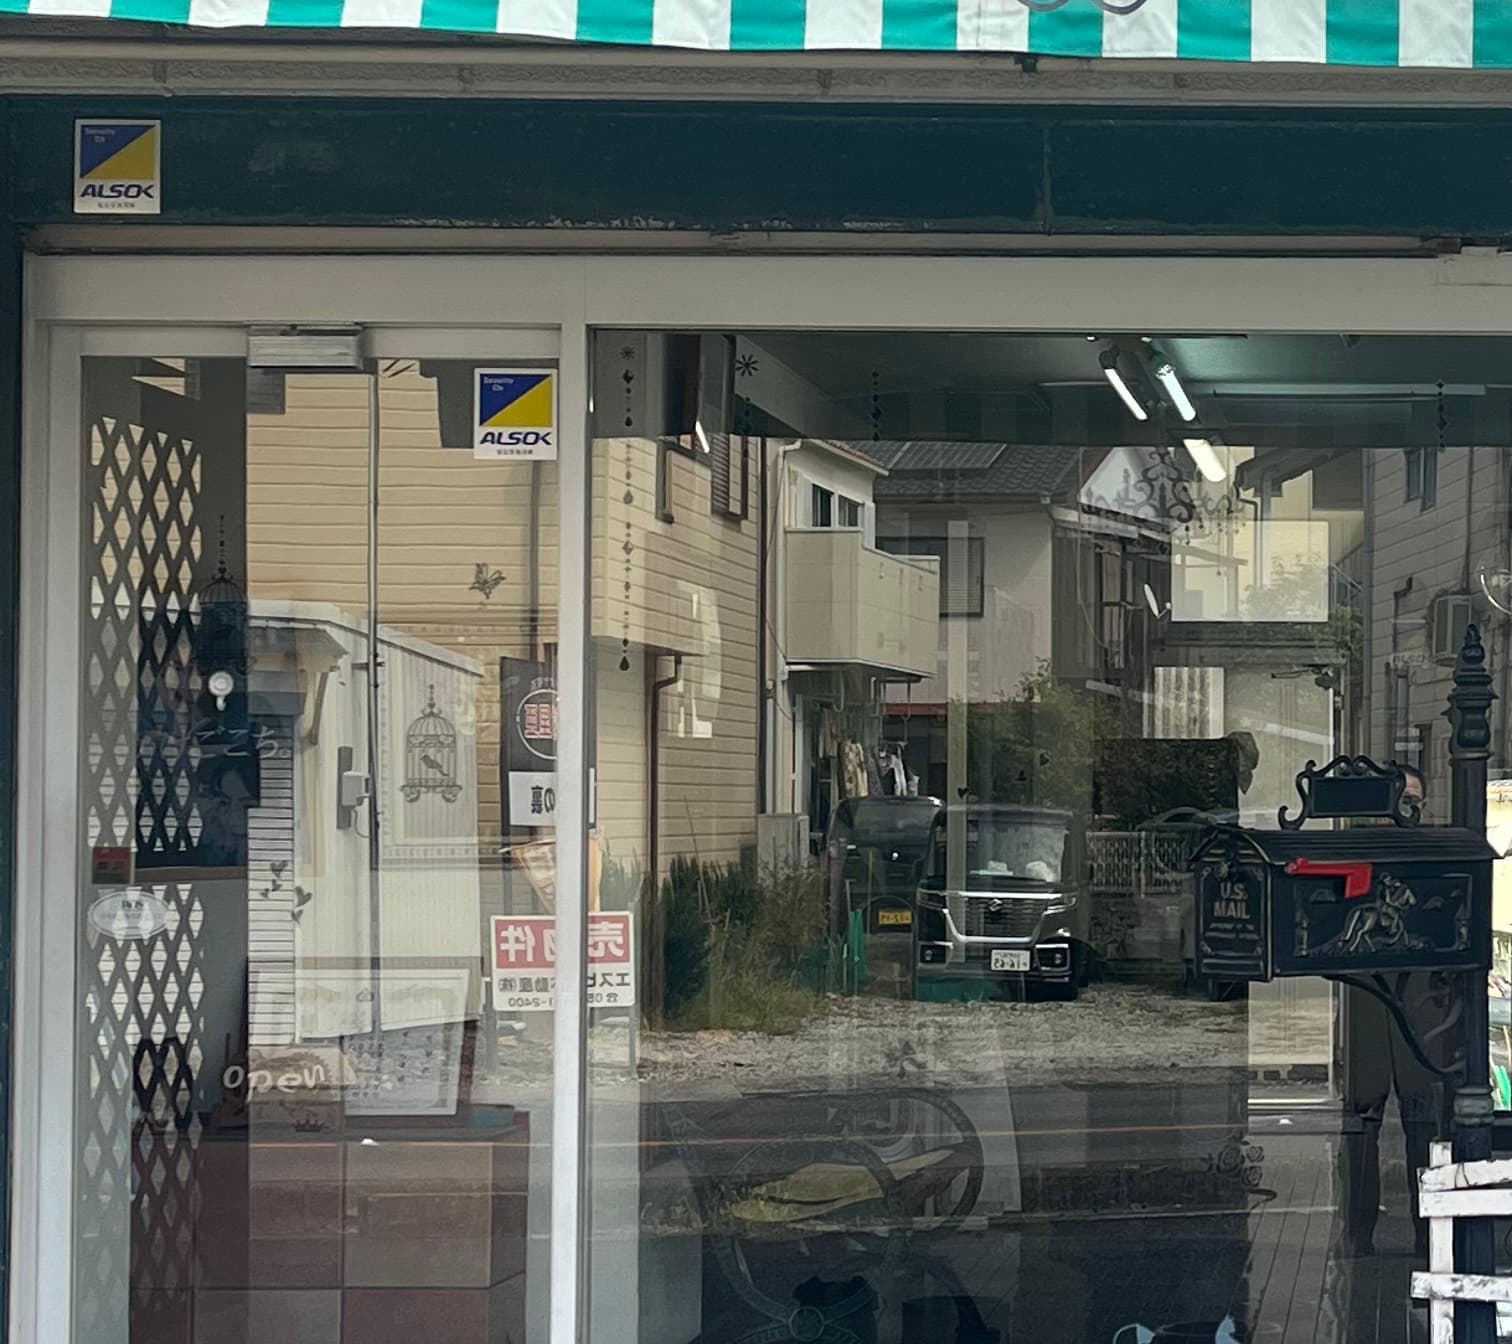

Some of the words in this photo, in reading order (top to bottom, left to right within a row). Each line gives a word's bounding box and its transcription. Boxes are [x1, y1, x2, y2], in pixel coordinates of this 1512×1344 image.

[80, 183, 155, 199] ALSOK
[480, 431, 553, 446] ALSOK
[1213, 900, 1251, 920] MAIL
